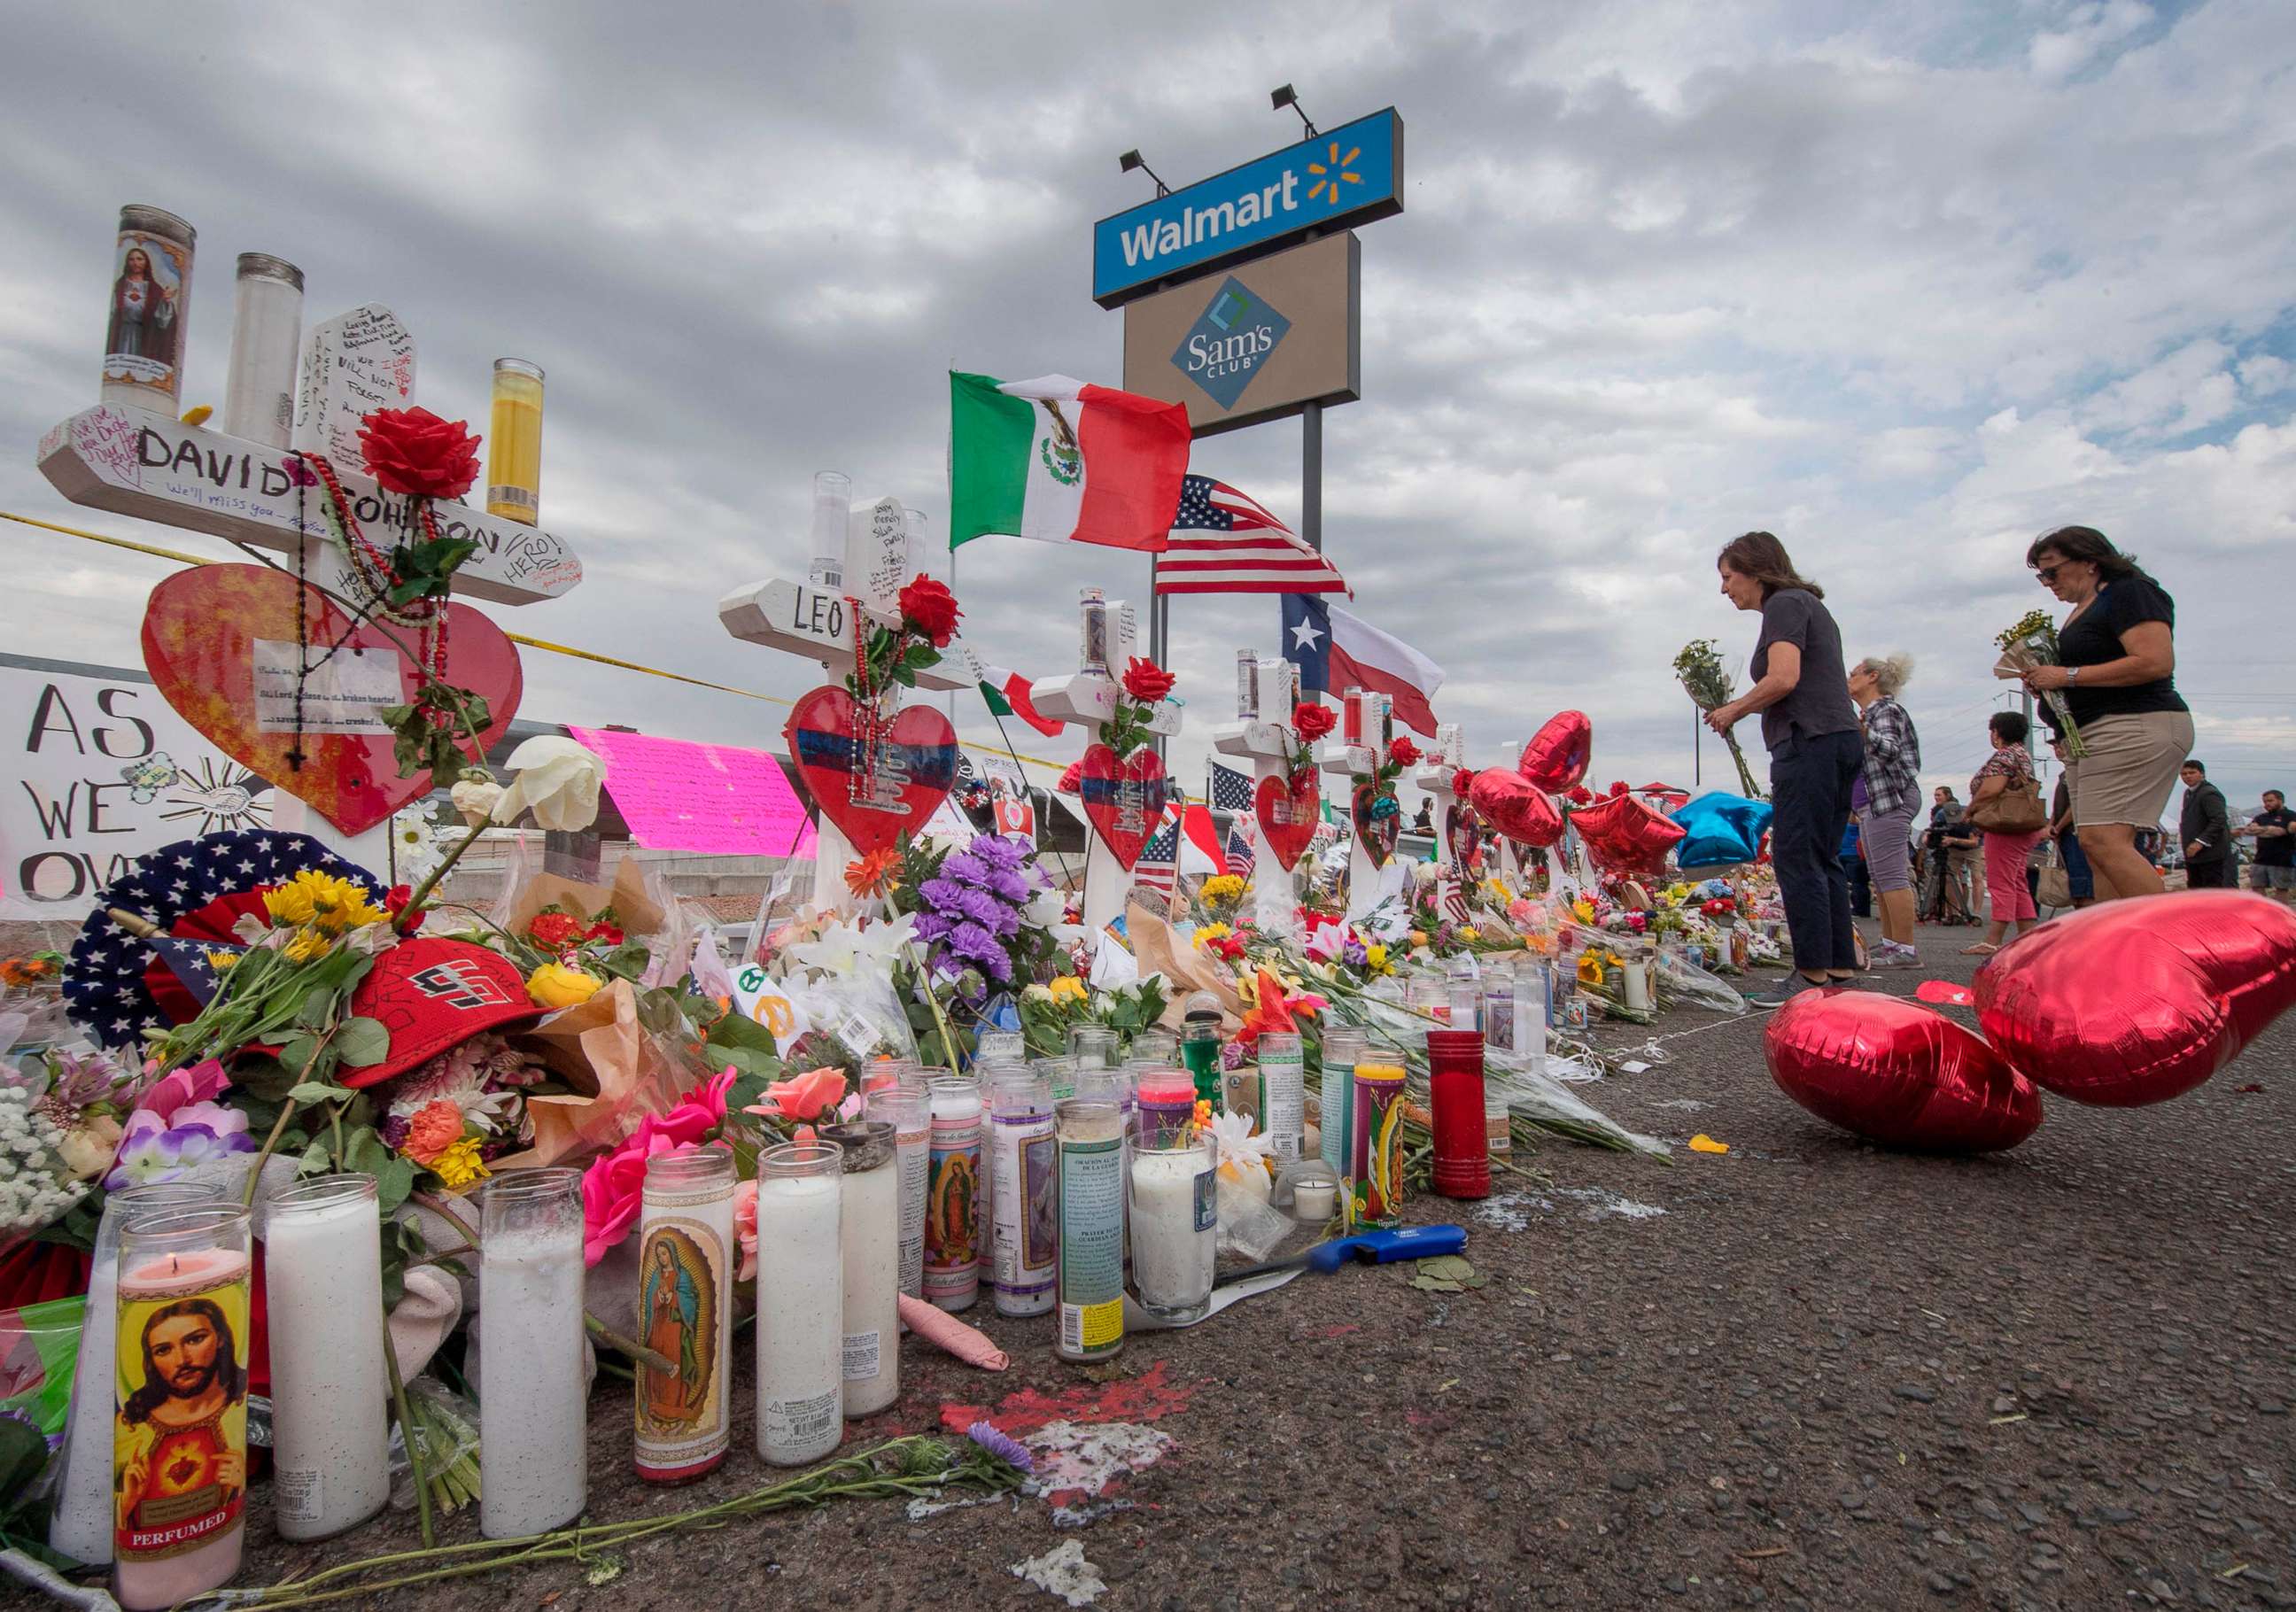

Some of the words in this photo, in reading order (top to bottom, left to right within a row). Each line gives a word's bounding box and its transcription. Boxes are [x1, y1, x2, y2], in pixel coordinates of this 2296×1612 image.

[1121, 169, 1299, 267] Walmart
[357, 356, 376, 368] WE
[1188, 325, 1273, 373] Sam's
[1206, 356, 1253, 379] CLUB
[337, 356, 367, 380] WILL
[371, 373, 396, 391] NOT
[138, 425, 291, 498] DAVID
[166, 481, 203, 504] We'll
[207, 495, 247, 511] miss
[250, 501, 275, 517] you
[503, 532, 563, 584] HERO!
[794, 585, 842, 639] LEO
[275, 690, 293, 700] Lord
[342, 694, 367, 703] broken
[368, 694, 397, 704] hearted
[27, 683, 155, 759] AS
[345, 717, 375, 726] crushed
[20, 778, 137, 841] WE
[132, 1511, 227, 1546] PERFUMED
